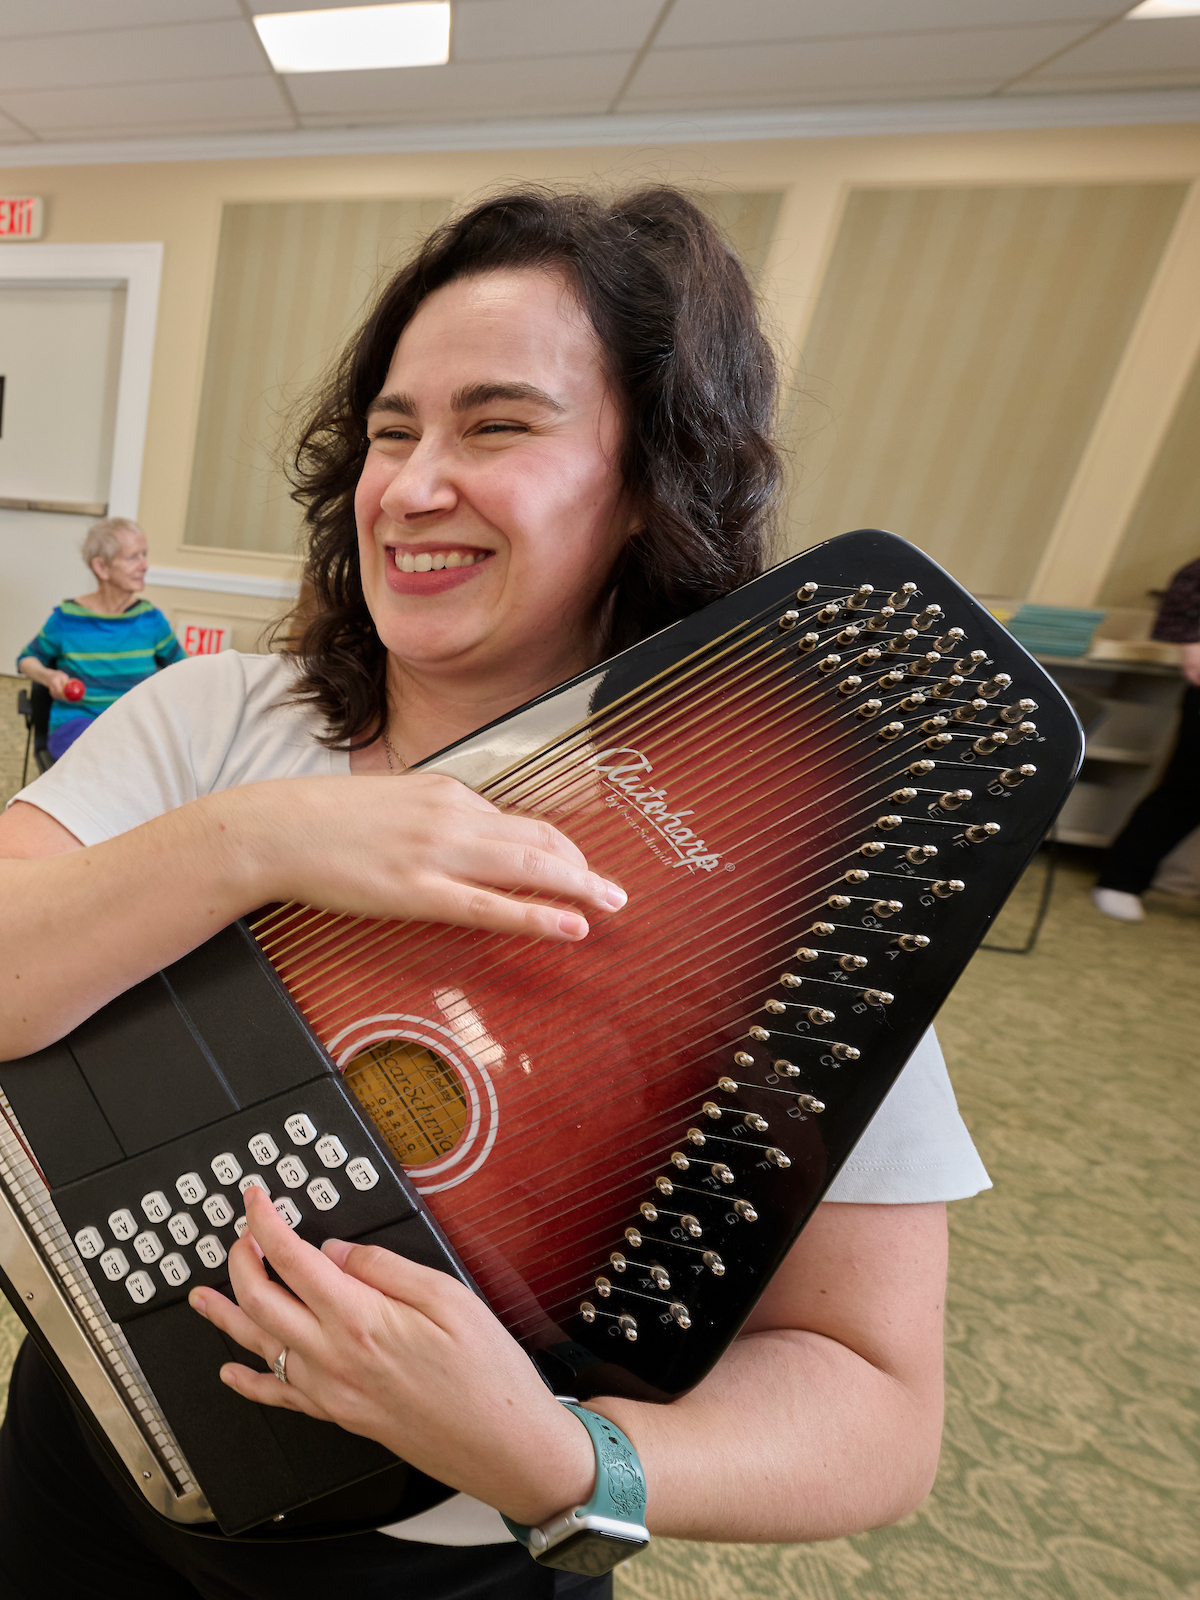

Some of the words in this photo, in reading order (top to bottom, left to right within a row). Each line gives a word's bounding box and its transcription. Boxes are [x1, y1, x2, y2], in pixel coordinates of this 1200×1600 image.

[184, 625, 225, 656] EXIT
[960, 751, 977, 763] D
[987, 784, 1013, 798] D#
[605, 793, 620, 808] by
[587, 748, 722, 871] Autoharp
[927, 807, 944, 819] E
[952, 839, 970, 849] F
[894, 862, 917, 876] F#
[919, 895, 936, 907] G
[861, 915, 884, 930] G#
[885, 950, 901, 961] A
[828, 970, 850, 982] A#
[852, 1002, 868, 1015] B
[795, 1021, 811, 1033] C
[819, 1054, 842, 1070] C#
[764, 1073, 780, 1086] D
[786, 1105, 809, 1122] D#
[288, 1119, 301, 1128] Maj
[731, 1124, 748, 1136] E
[252, 1139, 265, 1148] Sev
[320, 1141, 331, 1149] Sev
[325, 1149, 340, 1162] F7
[214, 1159, 226, 1168] Min
[280, 1161, 292, 1170] Sev
[348, 1163, 362, 1173] Maj
[755, 1160, 772, 1171] F
[286, 1170, 300, 1182] C7
[180, 1179, 190, 1188] Min
[243, 1180, 254, 1188] Sev
[310, 1183, 323, 1194] Maj
[701, 1175, 722, 1191] F#
[144, 1198, 156, 1207] Min
[207, 1200, 218, 1209] Sev
[276, 1204, 286, 1212] Ma
[112, 1216, 123, 1224] Min
[212, 1208, 226, 1221] D7
[285, 1211, 294, 1226] F
[724, 1212, 740, 1225] G
[172, 1219, 182, 1228] Sev
[78, 1234, 89, 1243] Min
[176, 1226, 188, 1240] A7
[670, 1226, 691, 1242] G#
[138, 1237, 148, 1245] Sev
[198, 1241, 212, 1252] Maj
[142, 1244, 155, 1258] E7
[207, 1250, 217, 1263] G
[108, 1263, 120, 1275] B7
[162, 1260, 175, 1270] Maj
[690, 1264, 705, 1276] A
[172, 1268, 181, 1281] D
[129, 1277, 140, 1287] Maj
[638, 1277, 657, 1289] A#
[136, 1285, 145, 1298] A
[658, 1311, 673, 1325] B
[608, 1325, 622, 1337] C
